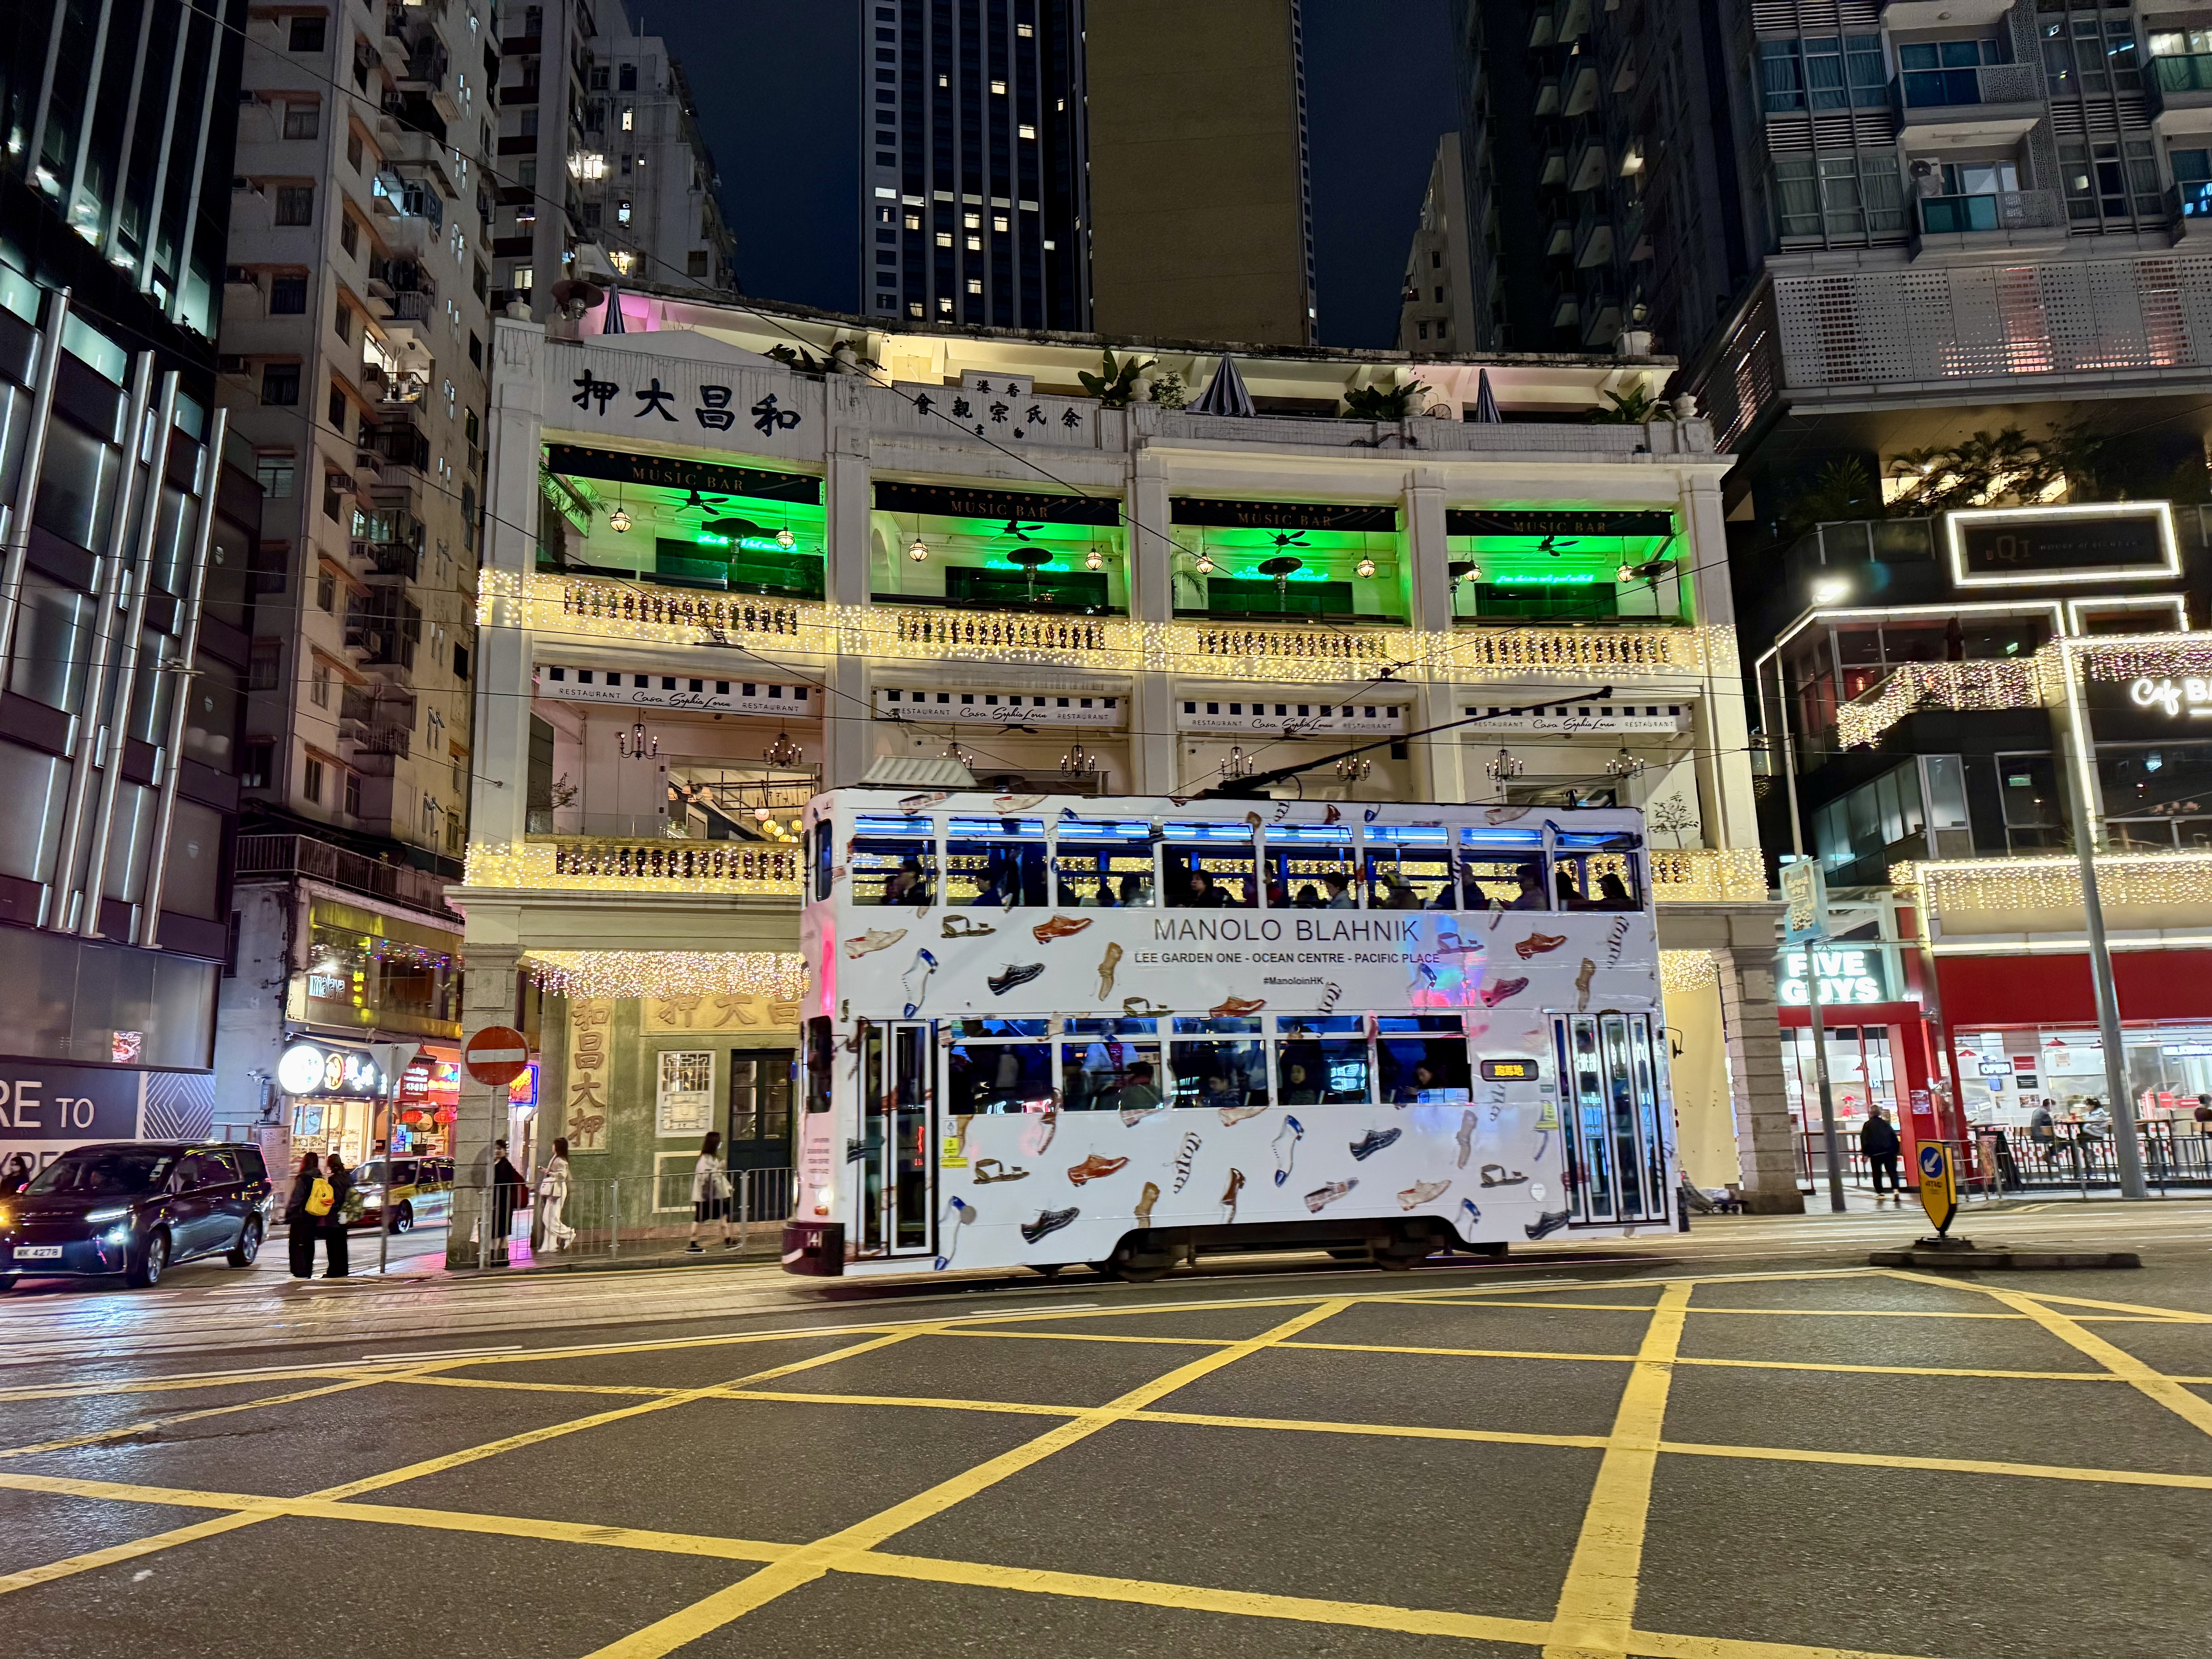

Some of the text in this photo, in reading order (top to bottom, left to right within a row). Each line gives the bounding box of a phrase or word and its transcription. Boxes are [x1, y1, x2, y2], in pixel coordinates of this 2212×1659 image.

[632, 467, 743, 491] MUSIC BAR
[951, 500, 1048, 518] MUSIC BAR
[1238, 513, 1331, 526] MUSIC BAR
[1513, 522, 1606, 532] MUSIC BAR
[559, 688, 621, 699] RESTAURANT
[632, 691, 665, 702] Casa
[669, 693, 704, 709] Sophia
[742, 702, 799, 712] RESTAURANT
[960, 707, 987, 718] Casa
[992, 707, 1024, 720] Sophia
[1022, 709, 1048, 721] Loren
[1252, 718, 1278, 729] Casa
[1533, 719, 1559, 730] Casa
[1563, 717, 1594, 732] Sophia
[1592, 719, 1616, 730] Loren
[1154, 919, 1420, 942] MANOLO BLAHNIK
[1135, 952, 1158, 963] LEE
[1162, 953, 1213, 963] GARDEN
[1216, 953, 1242, 963] ONE
[1252, 953, 1294, 963] OCEAN
[1298, 953, 1345, 963] CENTRE
[1354, 953, 1399, 963] PACIFIC
[1402, 953, 1440, 963] PLACE
[1787, 951, 1867, 978] FIVE
[1263, 977, 1324, 986] #ManoloinHK
[1781, 977, 1879, 1005] GUYS
[567, 998, 610, 1147] 和昌大押
[55, 1098, 94, 1128] TO
[33, 1248, 58, 1256] 4278
